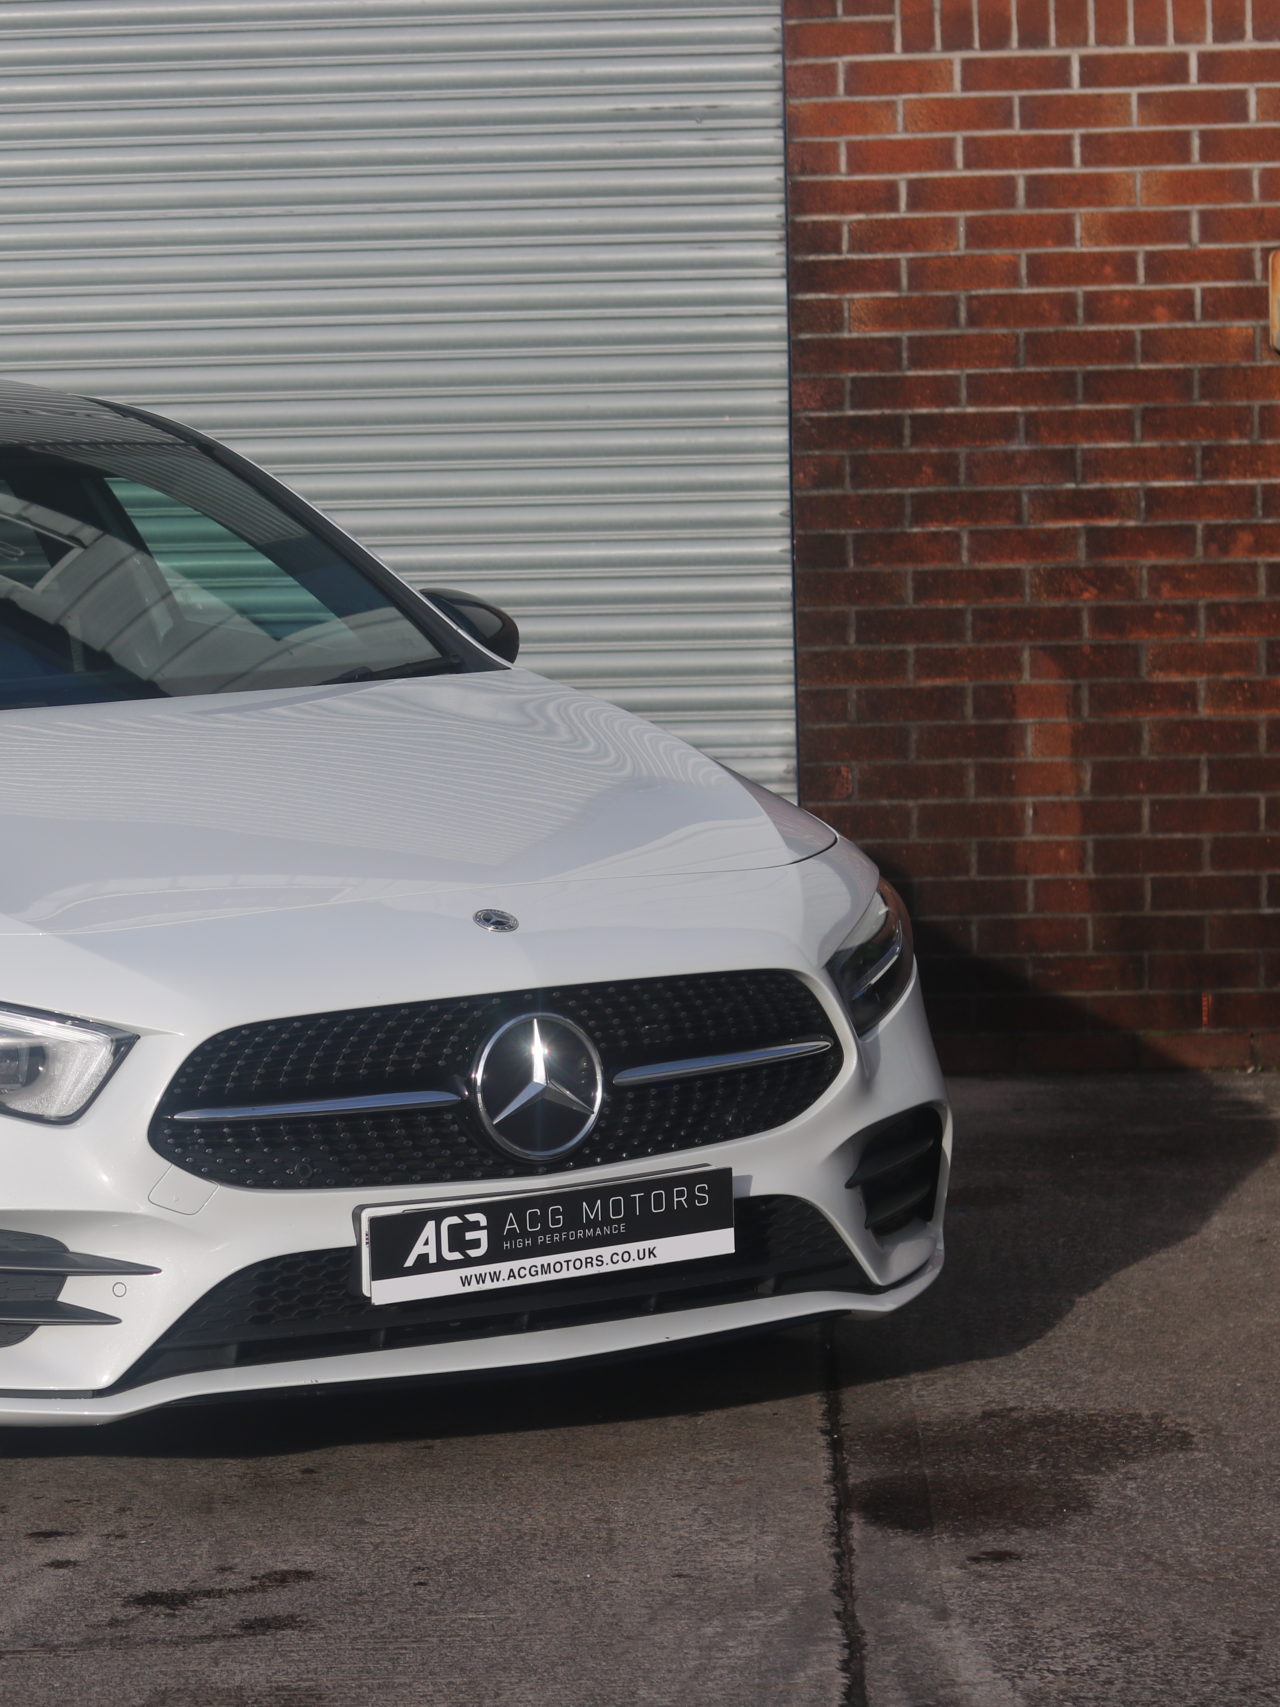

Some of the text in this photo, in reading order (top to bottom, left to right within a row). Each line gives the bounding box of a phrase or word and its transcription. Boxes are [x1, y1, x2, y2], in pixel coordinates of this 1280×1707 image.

[503, 1183, 709, 1236] ACG MOTORS
[503, 1223, 627, 1250] HIGH PERFORMANCE
[459, 1246, 658, 1288] WWW.ACGMOTORS.CO.UK
